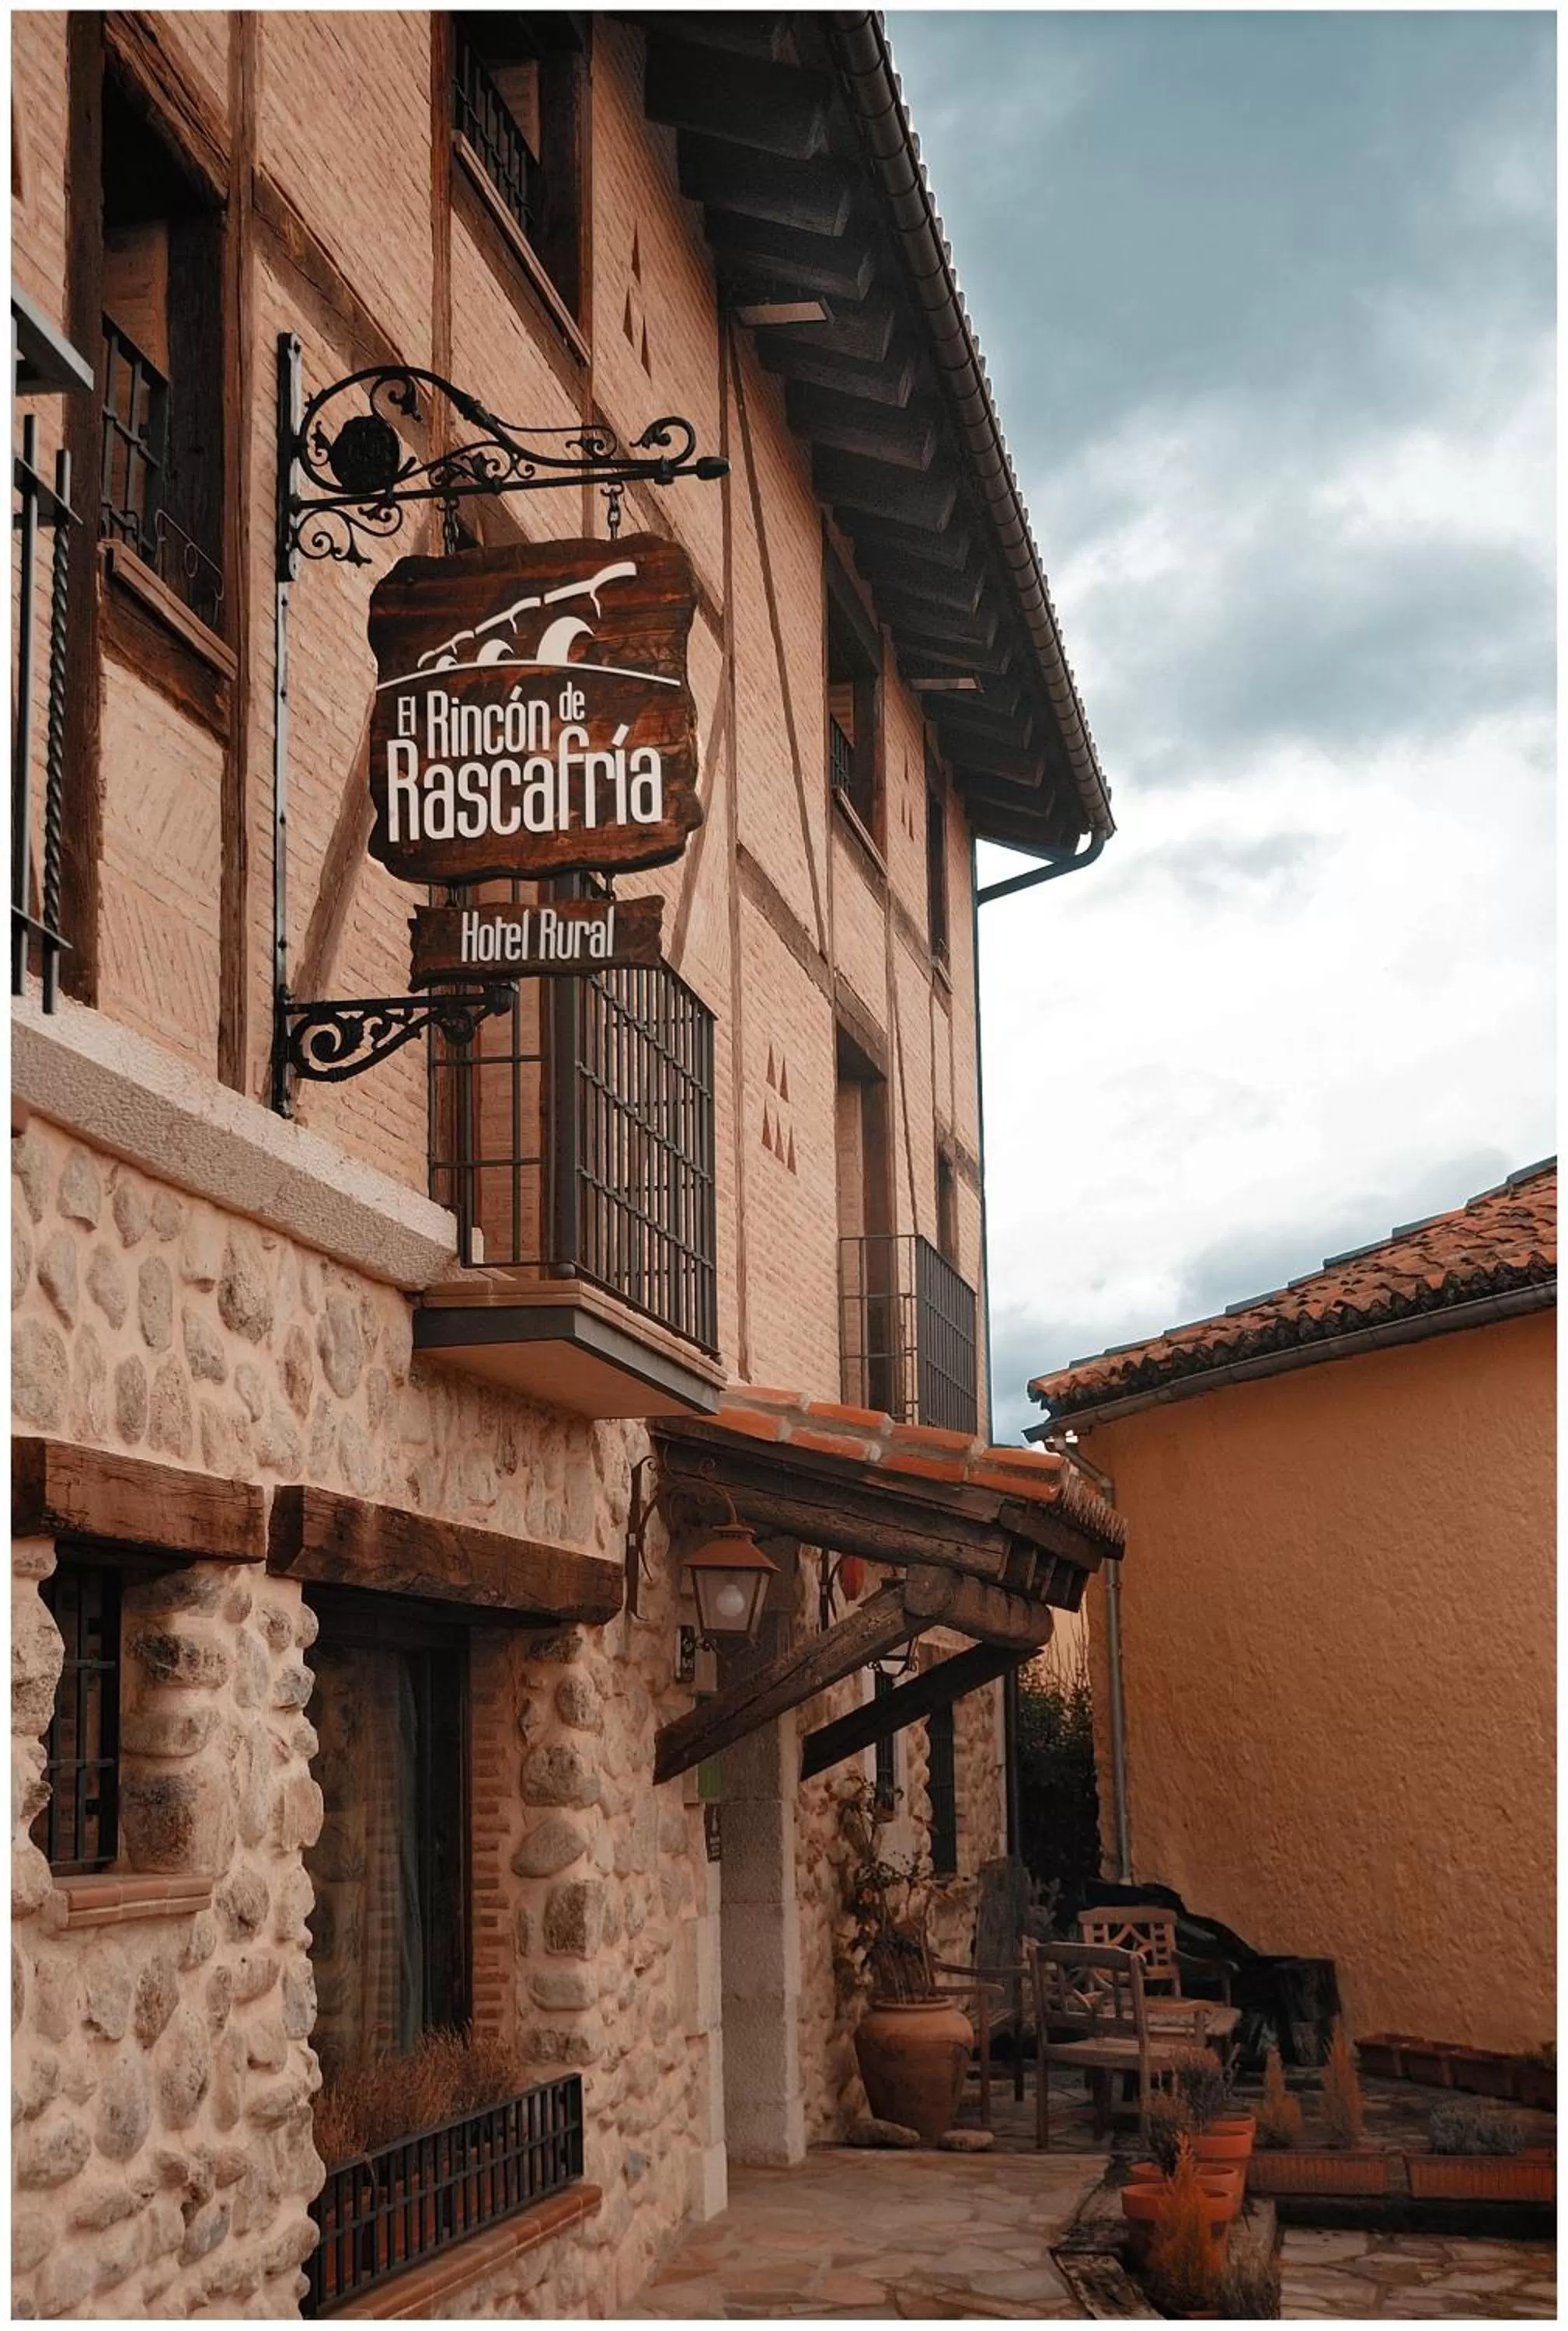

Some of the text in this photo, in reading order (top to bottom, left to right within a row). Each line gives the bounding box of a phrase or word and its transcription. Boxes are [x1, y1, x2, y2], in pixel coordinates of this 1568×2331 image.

[398, 681, 585, 759] El Rincón de
[387, 723, 664, 842] Rascafría
[461, 905, 615, 962] Hotel Rural
